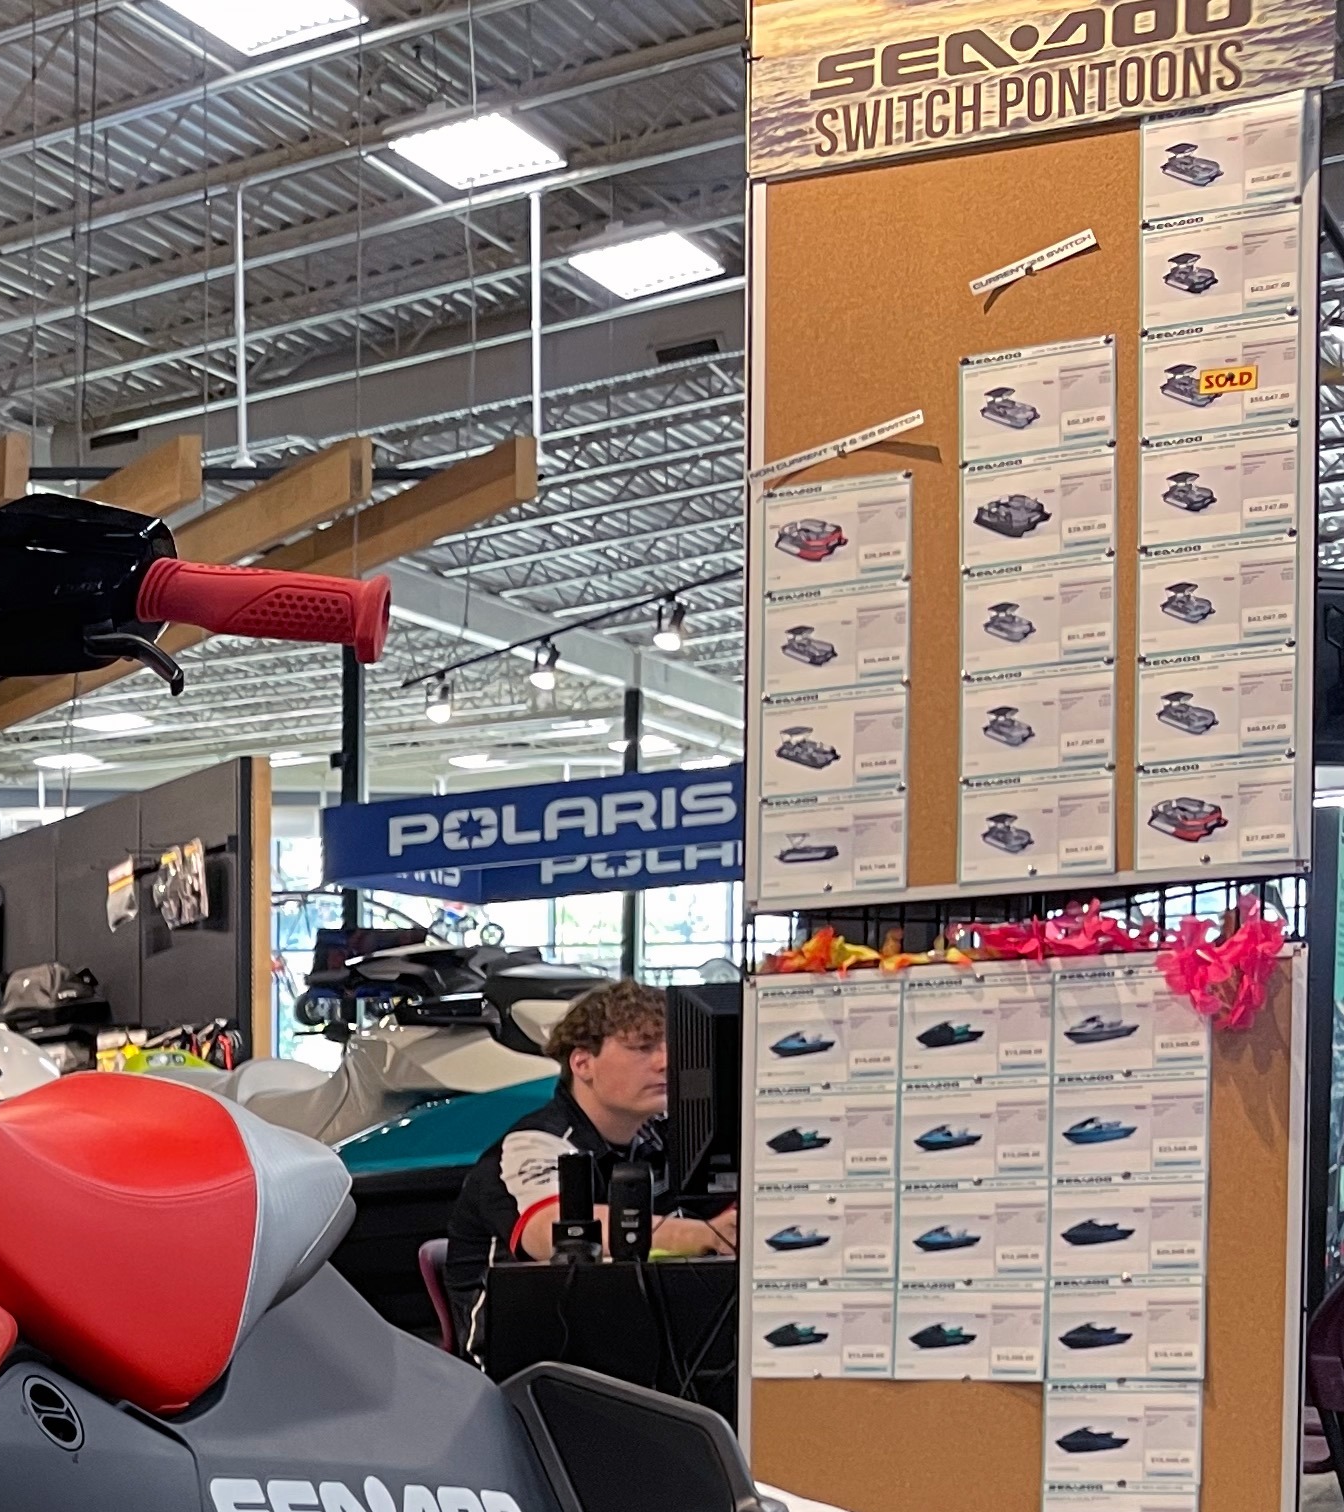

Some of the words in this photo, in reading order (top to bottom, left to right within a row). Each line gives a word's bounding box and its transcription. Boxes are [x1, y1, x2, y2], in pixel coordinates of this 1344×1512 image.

[815, 83, 983, 158] SWITCH
[998, 40, 1244, 131] PONTOONS
[973, 264, 1025, 290] CURRENT
[1046, 234, 1092, 259] SWITCH
[1204, 371, 1253, 391] SOLD
[388, 781, 738, 857] POLARIS
[540, 841, 743, 885] POLA
